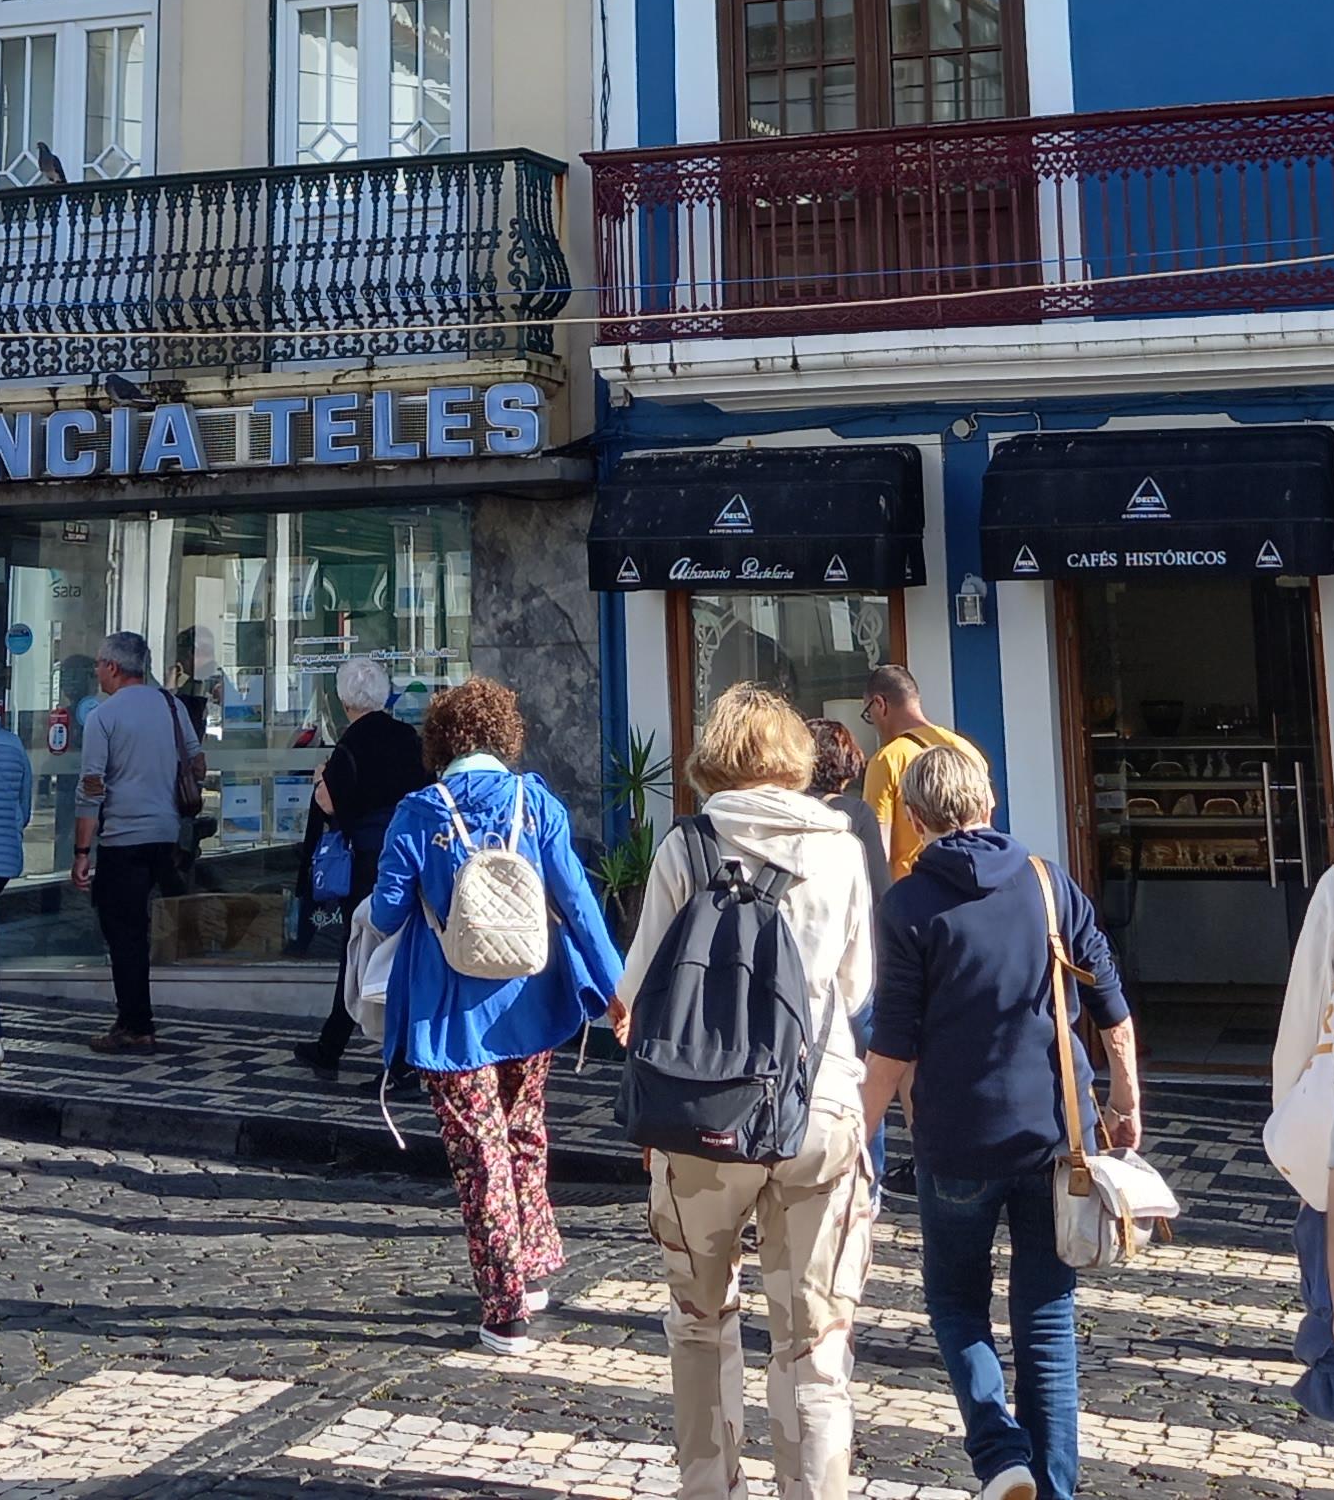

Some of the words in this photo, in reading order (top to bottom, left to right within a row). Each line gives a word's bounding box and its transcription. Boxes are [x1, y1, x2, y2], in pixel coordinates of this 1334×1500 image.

[252, 382, 540, 465] TELES
[669, 556, 731, 580] Athanasio
[735, 556, 795, 579] Pastelaria
[1067, 551, 1117, 567] CAFÉS
[1125, 549, 1227, 566] HISTÓRICOS
[52, 584, 82, 598] sata
